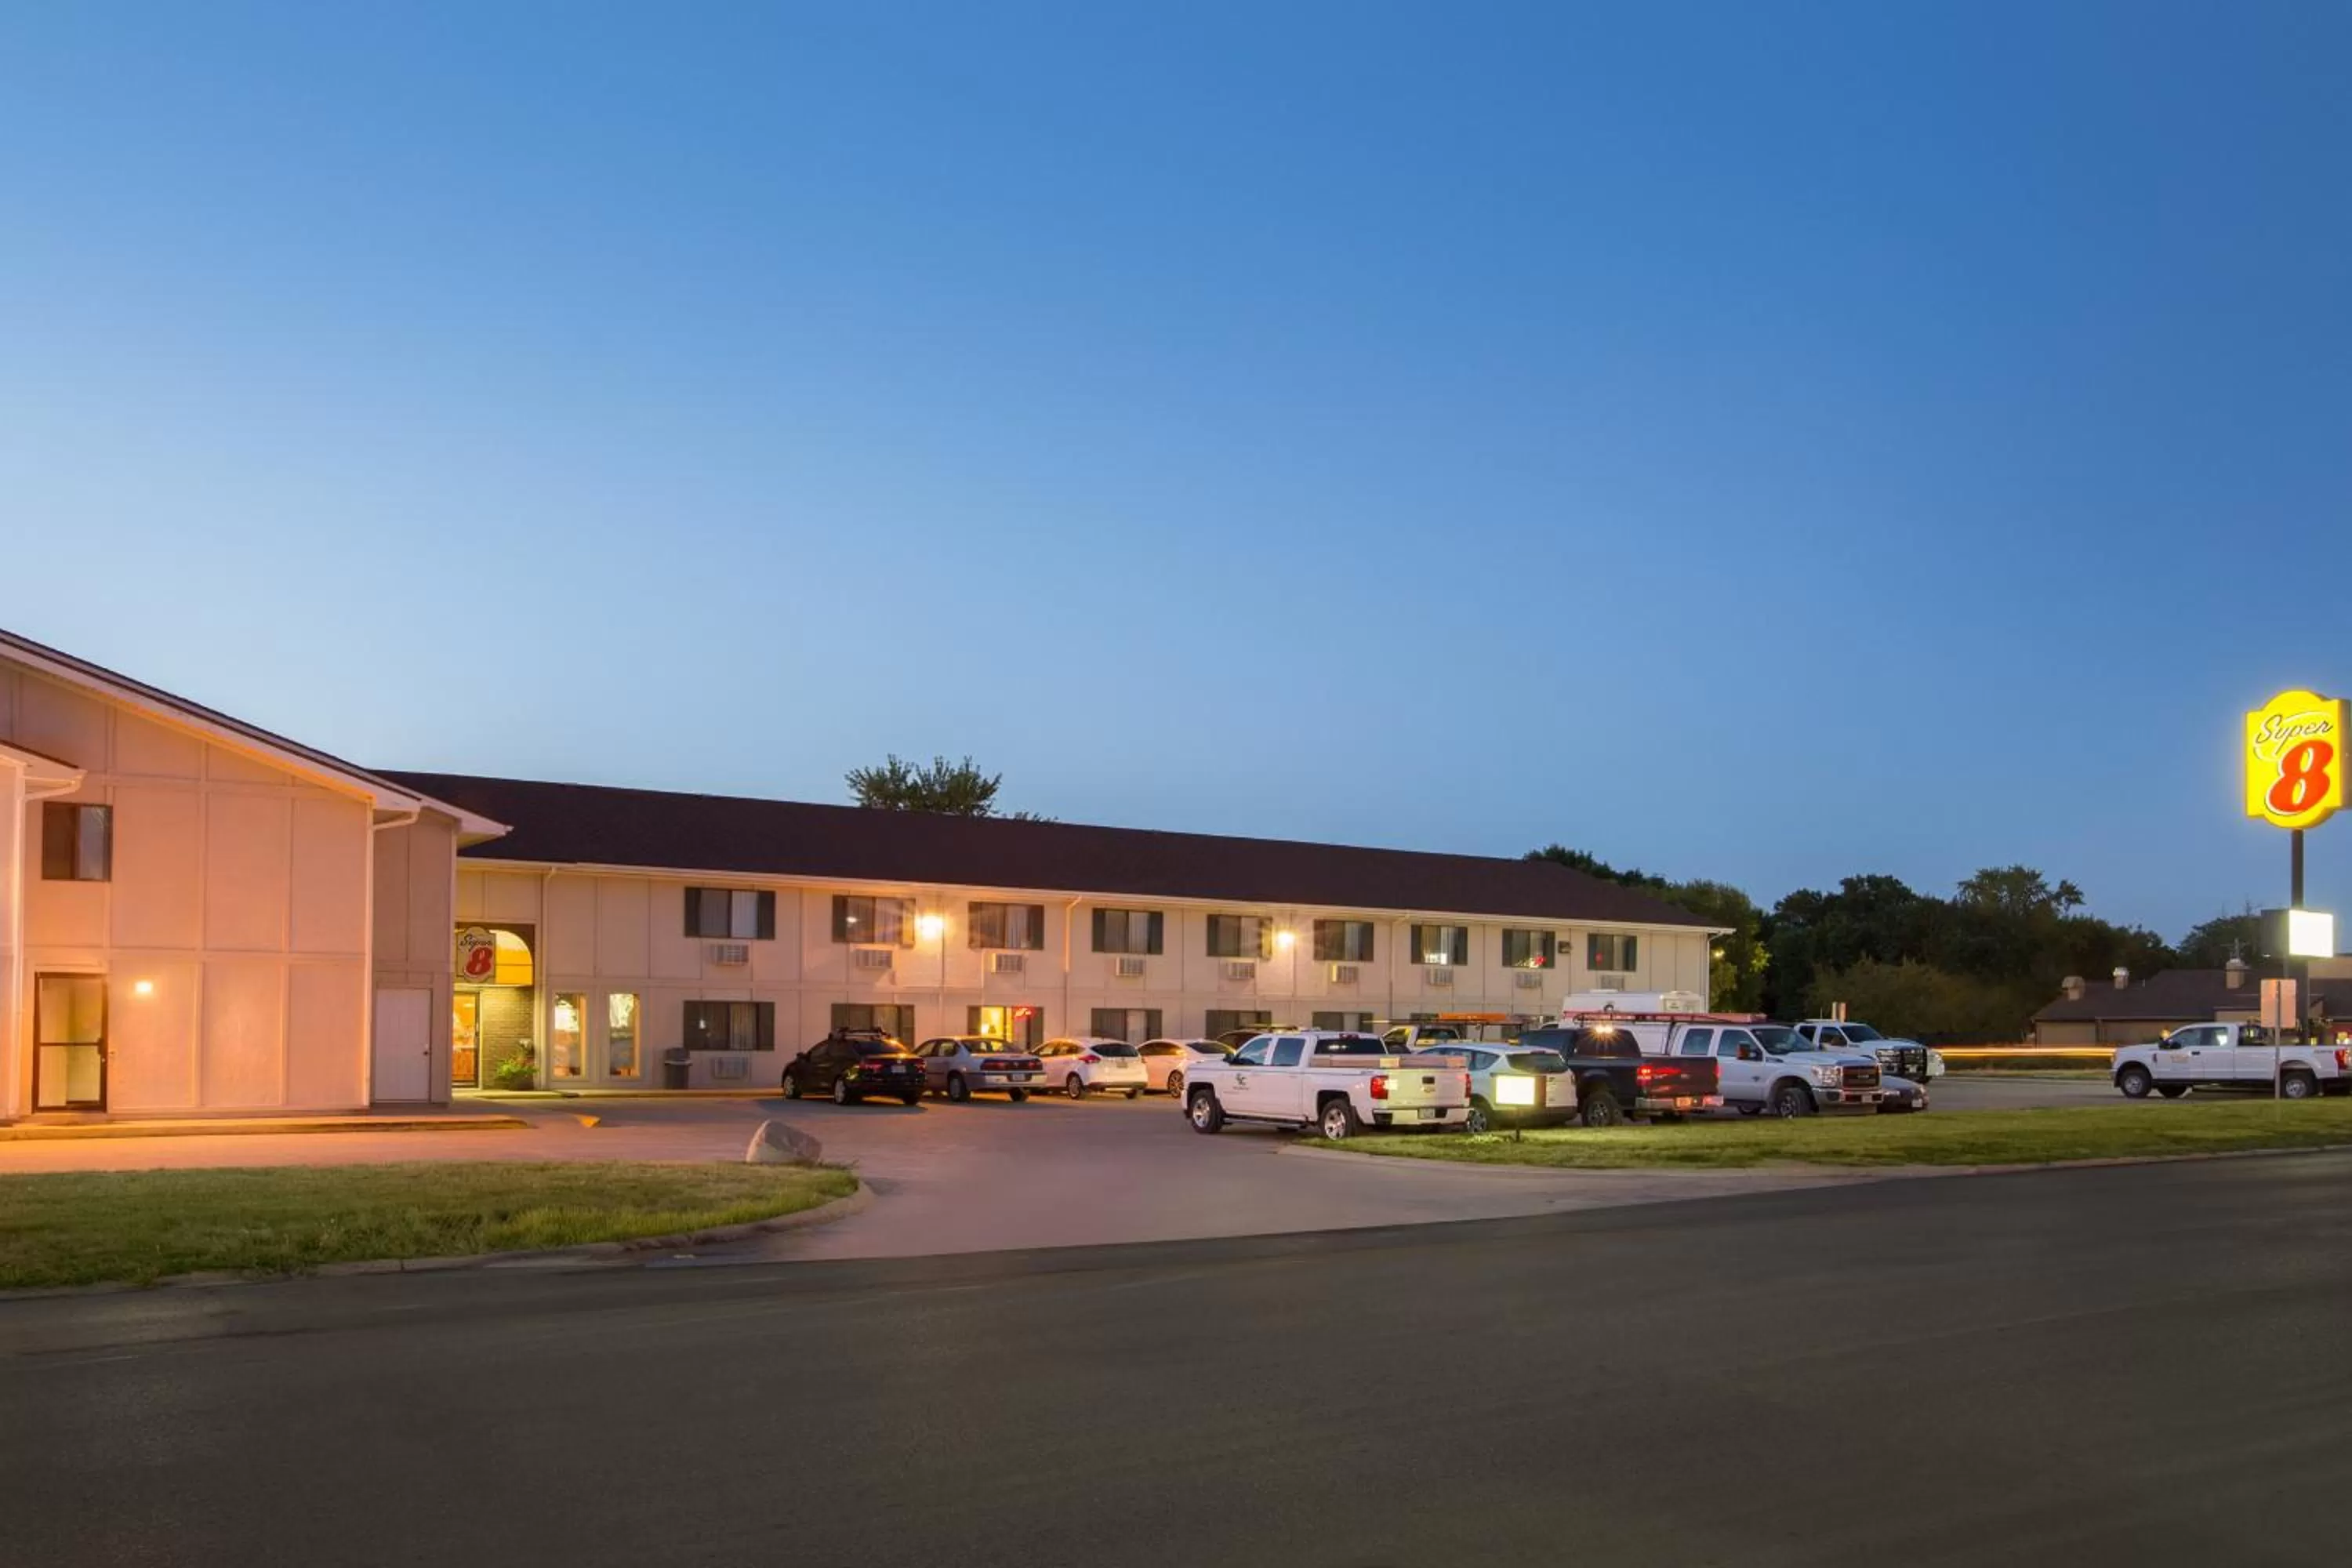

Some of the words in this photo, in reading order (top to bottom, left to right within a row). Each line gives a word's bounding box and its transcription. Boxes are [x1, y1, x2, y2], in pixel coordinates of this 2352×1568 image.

[2255, 714, 2333, 757] Super
[2265, 739, 2334, 815] 8
[465, 946, 493, 977] 8
